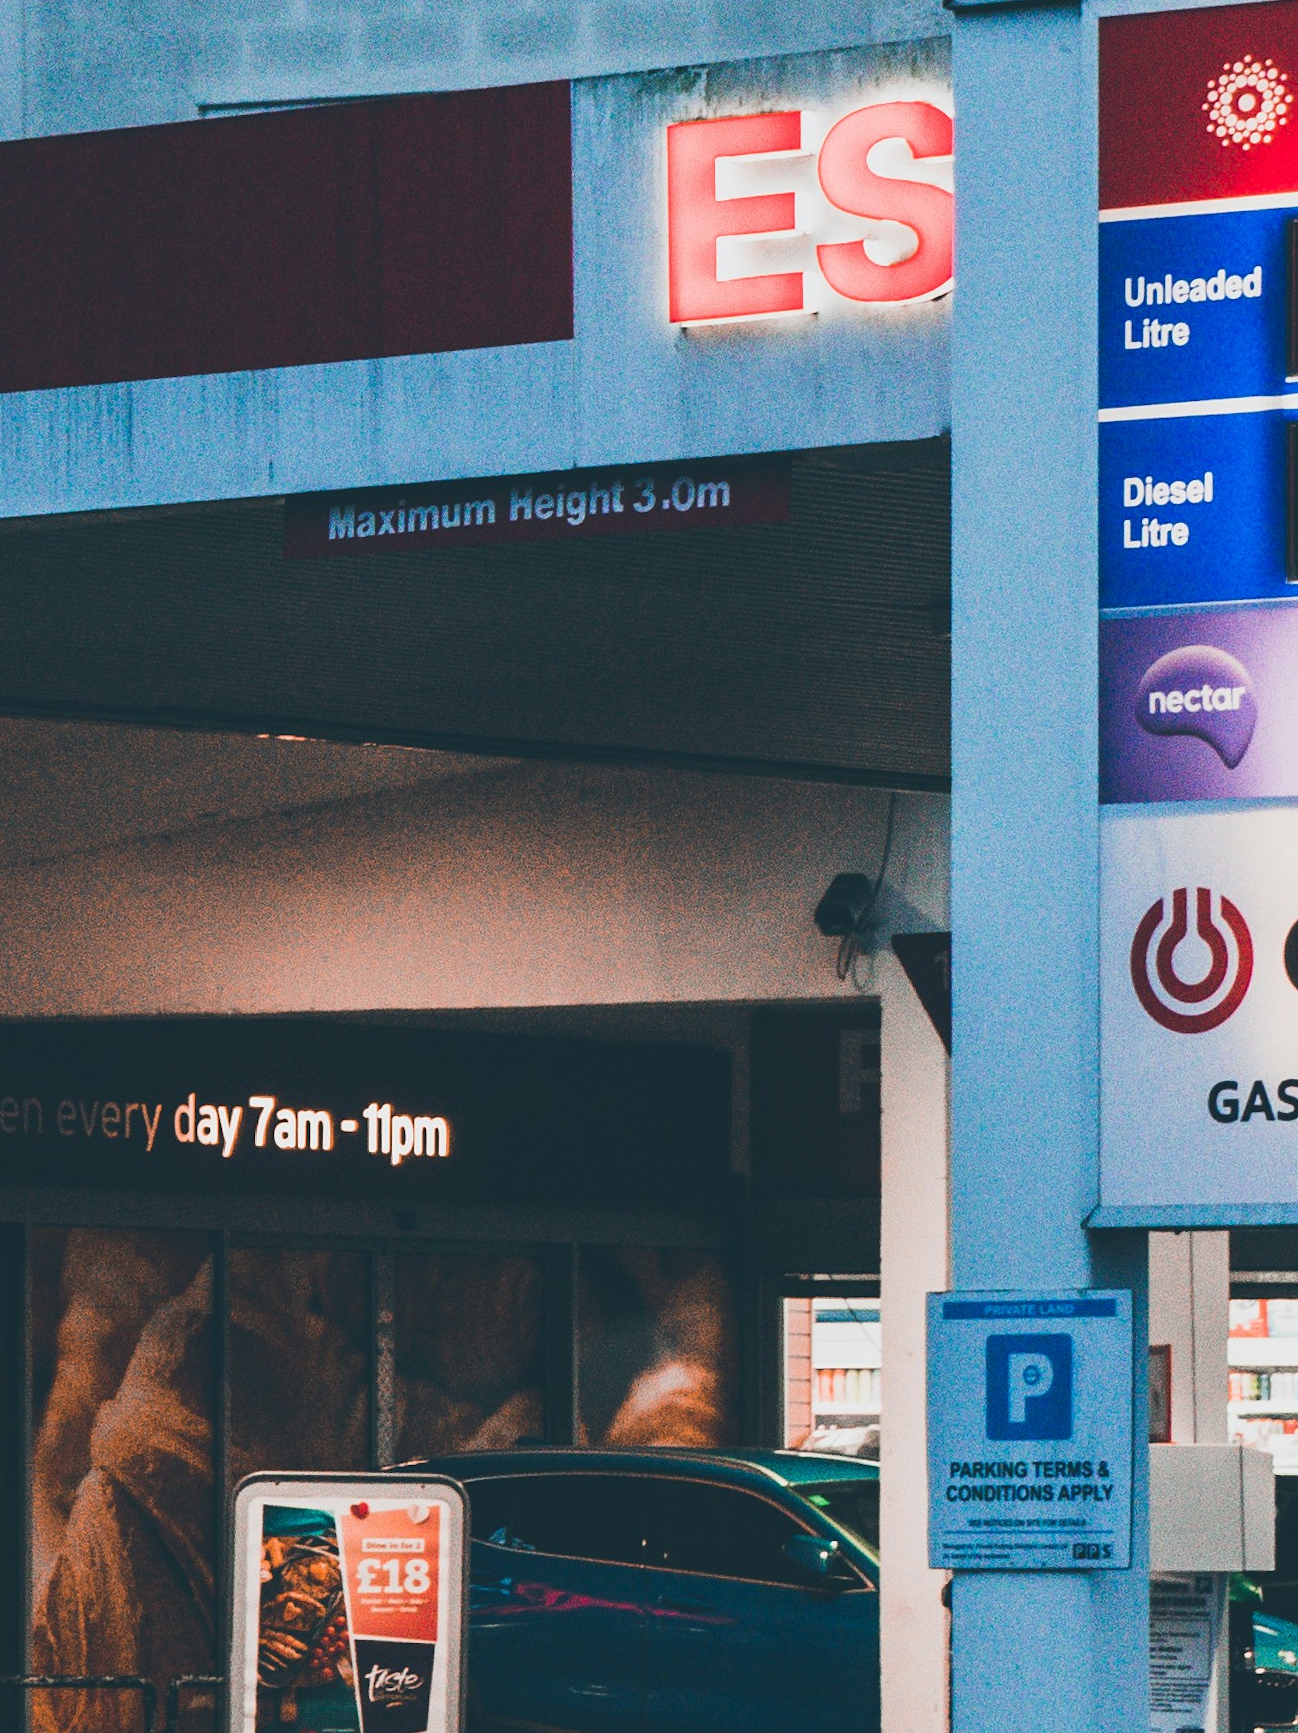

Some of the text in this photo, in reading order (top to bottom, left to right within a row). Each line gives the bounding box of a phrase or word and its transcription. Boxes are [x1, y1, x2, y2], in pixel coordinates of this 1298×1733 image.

[1124, 266, 1263, 308] Unleaded
[1124, 319, 1190, 350] Litre
[1123, 472, 1214, 507] Diesel
[327, 498, 497, 541] Maximum
[509, 479, 624, 526] Height
[1123, 520, 1189, 549] Litre
[1148, 683, 1247, 715] nectar
[56, 1099, 163, 1152] every
[173, 1093, 243, 1158] day
[248, 1095, 334, 1151] 7am
[362, 1103, 450, 1166] 11pm
[949, 1460, 1110, 1478] PARKING TERMS &
[945, 1483, 1114, 1502] CONDITIONS APPLY
[356, 1557, 431, 1595] £18
